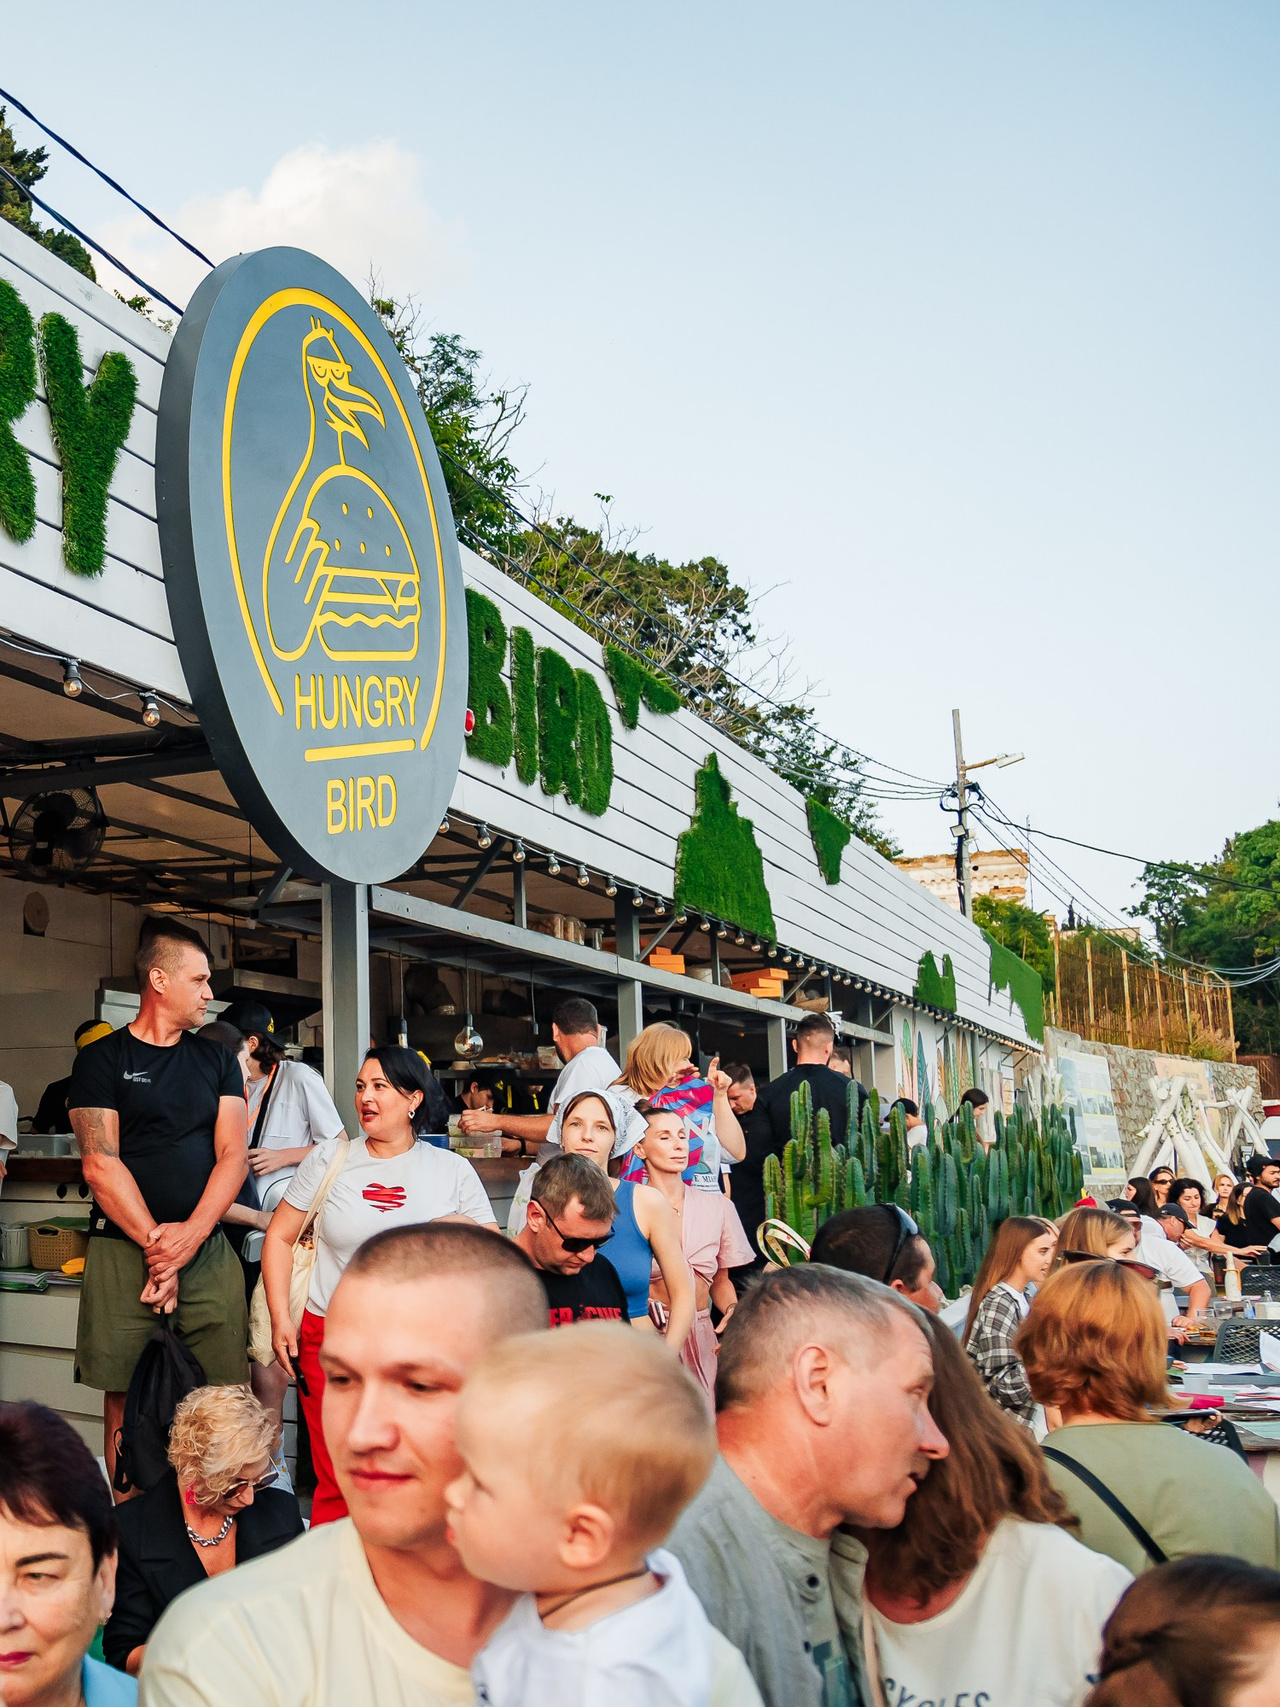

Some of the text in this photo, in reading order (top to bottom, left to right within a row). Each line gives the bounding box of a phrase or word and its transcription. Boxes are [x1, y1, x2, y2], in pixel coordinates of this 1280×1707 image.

[294, 673, 421, 731] HUNGRY
[465, 586, 614, 818] BIRD
[326, 775, 398, 835] BIRD
